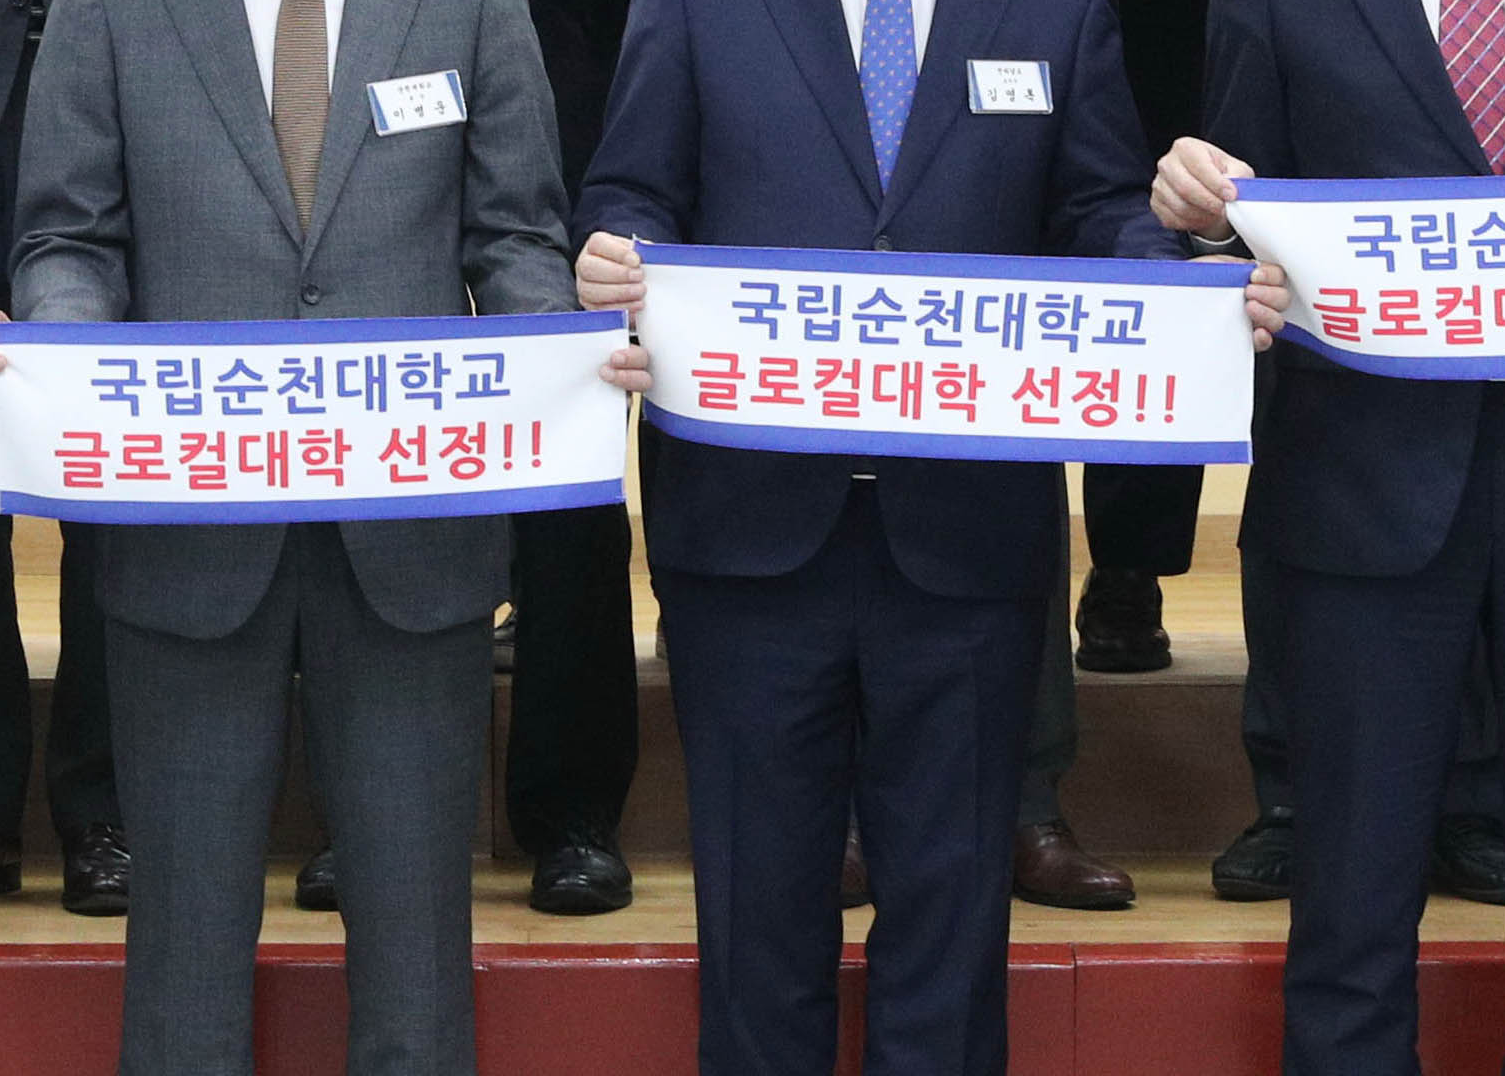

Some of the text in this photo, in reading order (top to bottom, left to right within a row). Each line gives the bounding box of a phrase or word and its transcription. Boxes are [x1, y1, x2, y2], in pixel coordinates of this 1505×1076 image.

[731, 281, 1148, 353] 국립순천대학교
[91, 351, 511, 417] 국립순천대학교
[691, 350, 1178, 428] 글로컬대학 선정!!
[54, 420, 543, 492] 글로컬대학 선정!!
